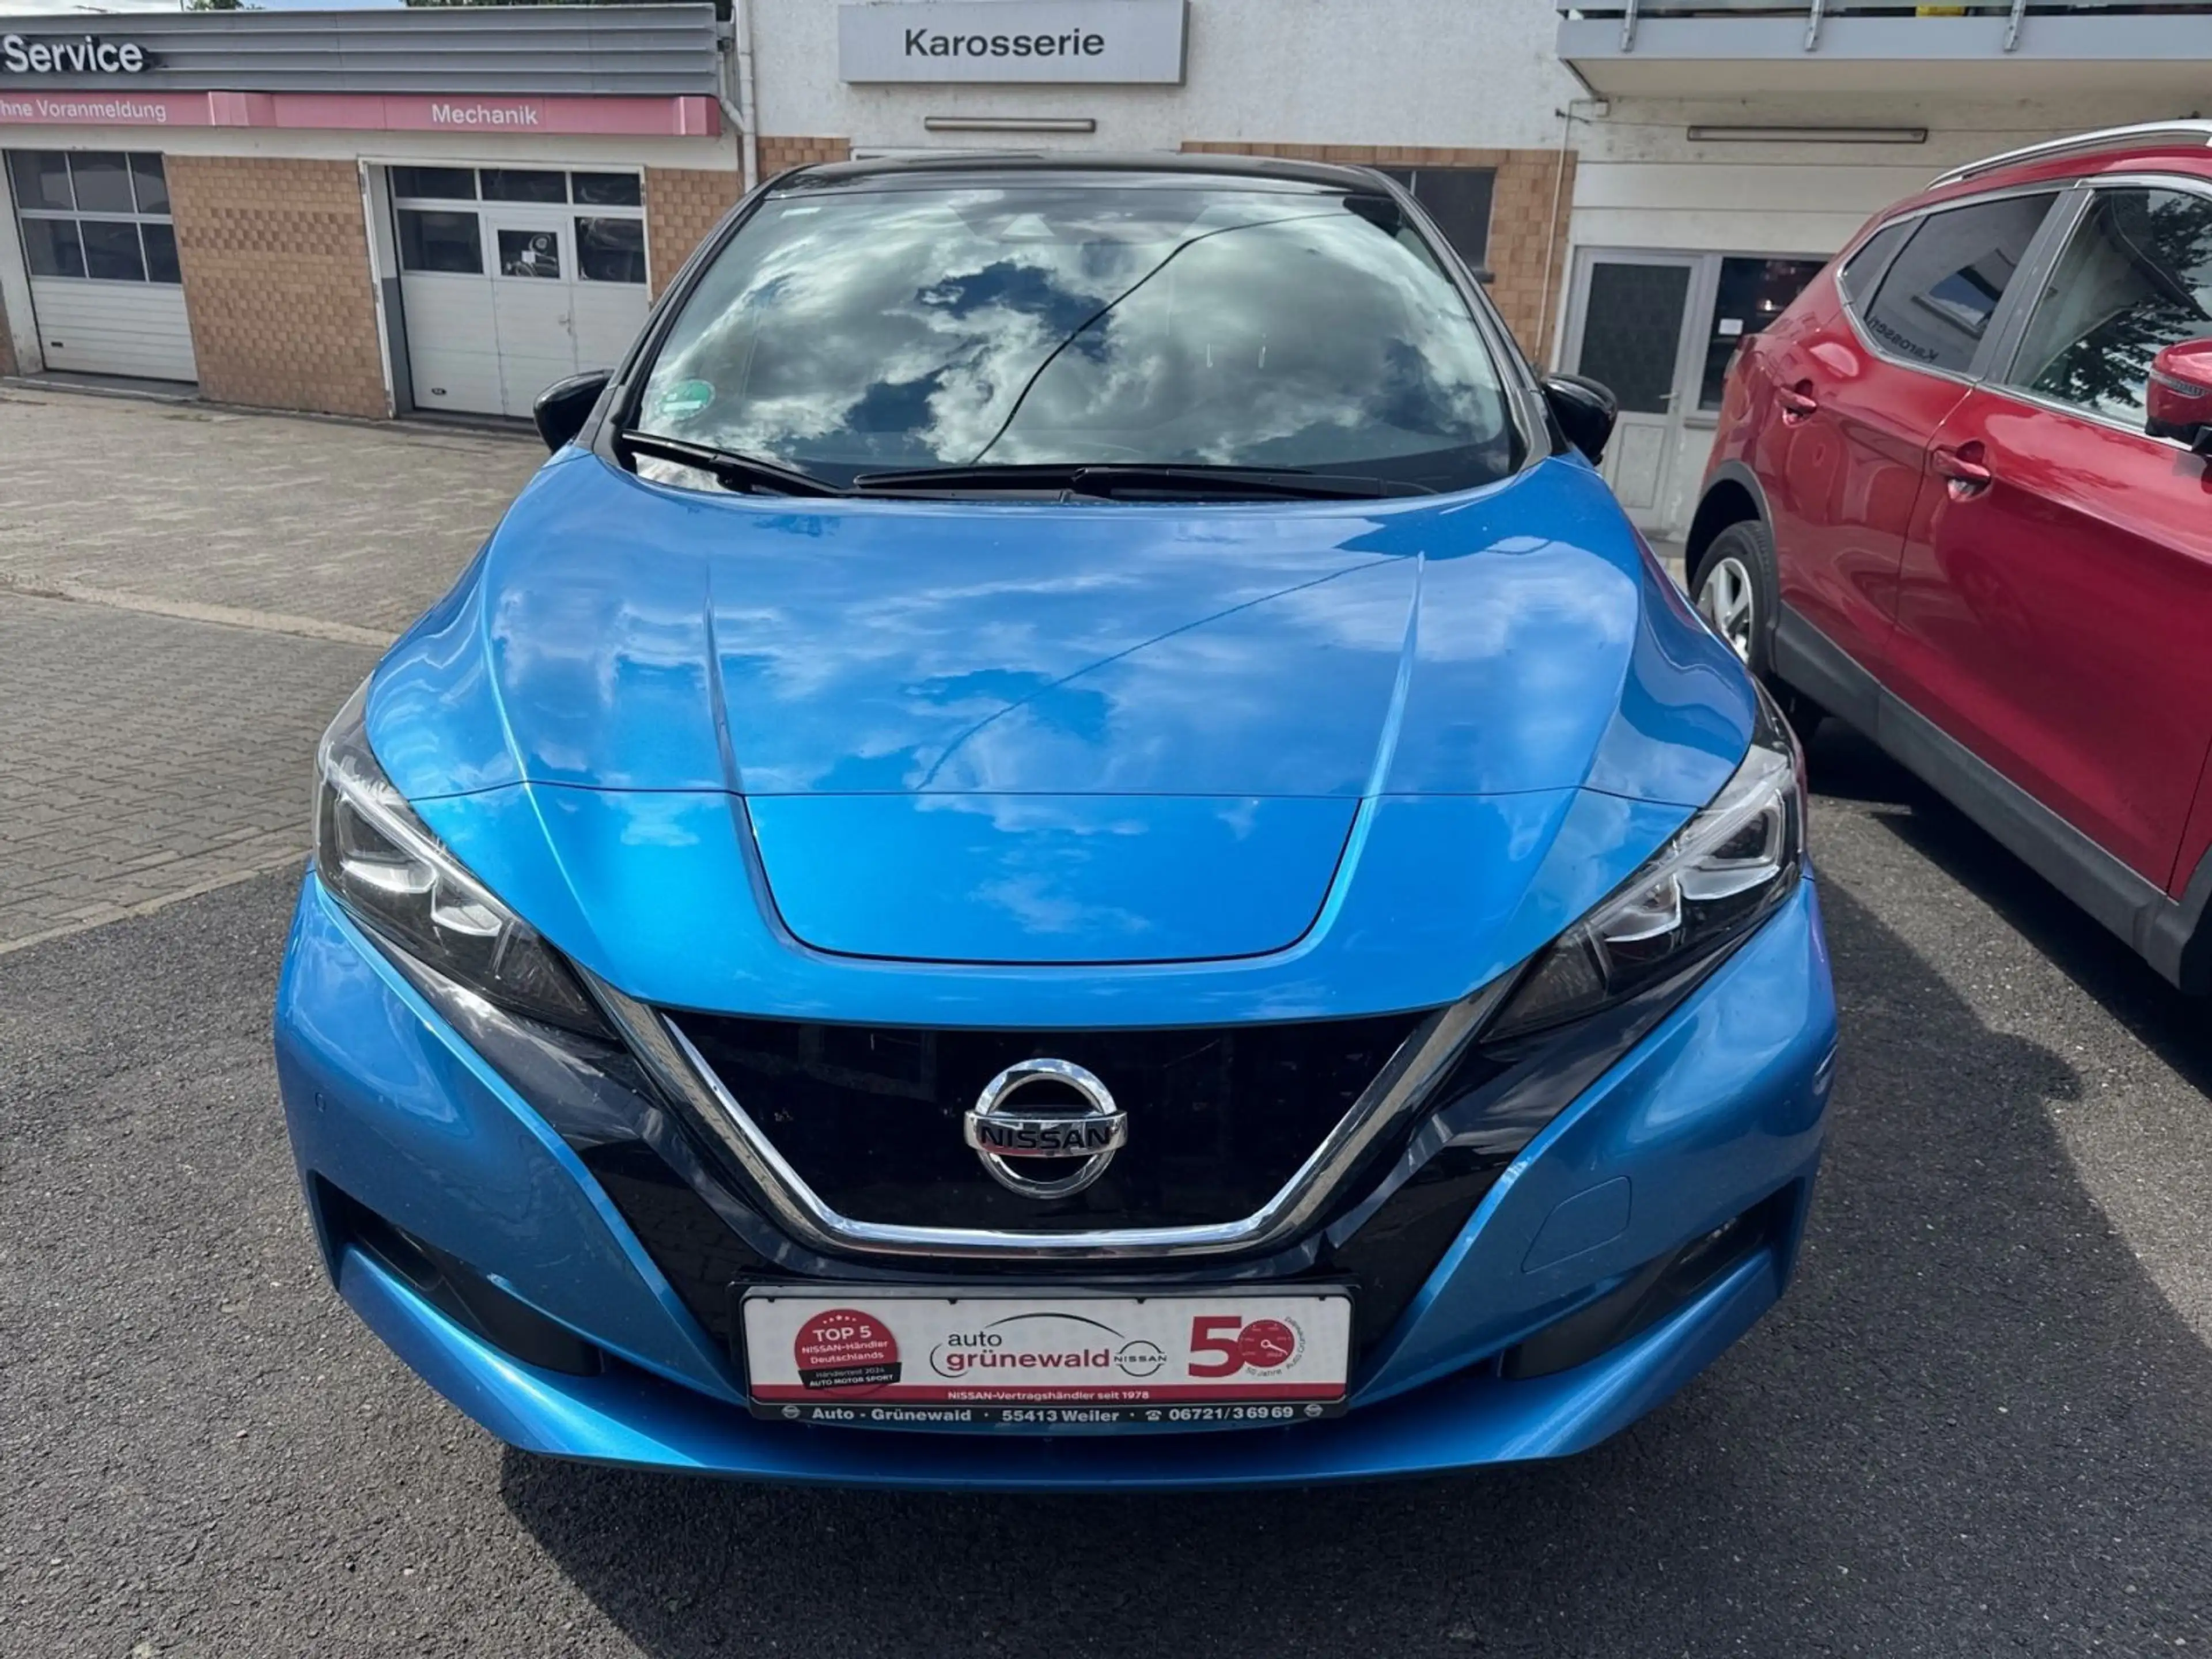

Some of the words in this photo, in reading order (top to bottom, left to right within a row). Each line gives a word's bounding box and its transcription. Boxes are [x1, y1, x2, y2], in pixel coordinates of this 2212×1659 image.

[905, 28, 1105, 57] Karosserie
[2, 34, 144, 73] Service
[0, 99, 33, 116] hne
[36, 99, 167, 123] Voranmeldung
[431, 103, 539, 126] Mechanik
[980, 1126, 1111, 1150] NISSAN
[812, 1327, 855, 1342] TOP
[859, 1325, 872, 1339] 5
[948, 1331, 1002, 1347] auto
[810, 1351, 885, 1365] Deutschlands
[946, 1349, 1110, 1372] grünewald
[1113, 1354, 1168, 1362] NISSAN
[809, 1379, 833, 1387] AUTO
[835, 1377, 864, 1385] MOTOR
[865, 1374, 893, 1382] SPORT
[948, 1391, 1095, 1401] NISSAN-Vertragshändler
[1097, 1391, 1120, 1400] seit
[1122, 1391, 1150, 1400] 1978
[812, 1407, 855, 1420] Auto
[871, 1408, 972, 1422] Grünewald
[1002, 1410, 1058, 1422] 55413
[1062, 1410, 1120, 1422] Weiler
